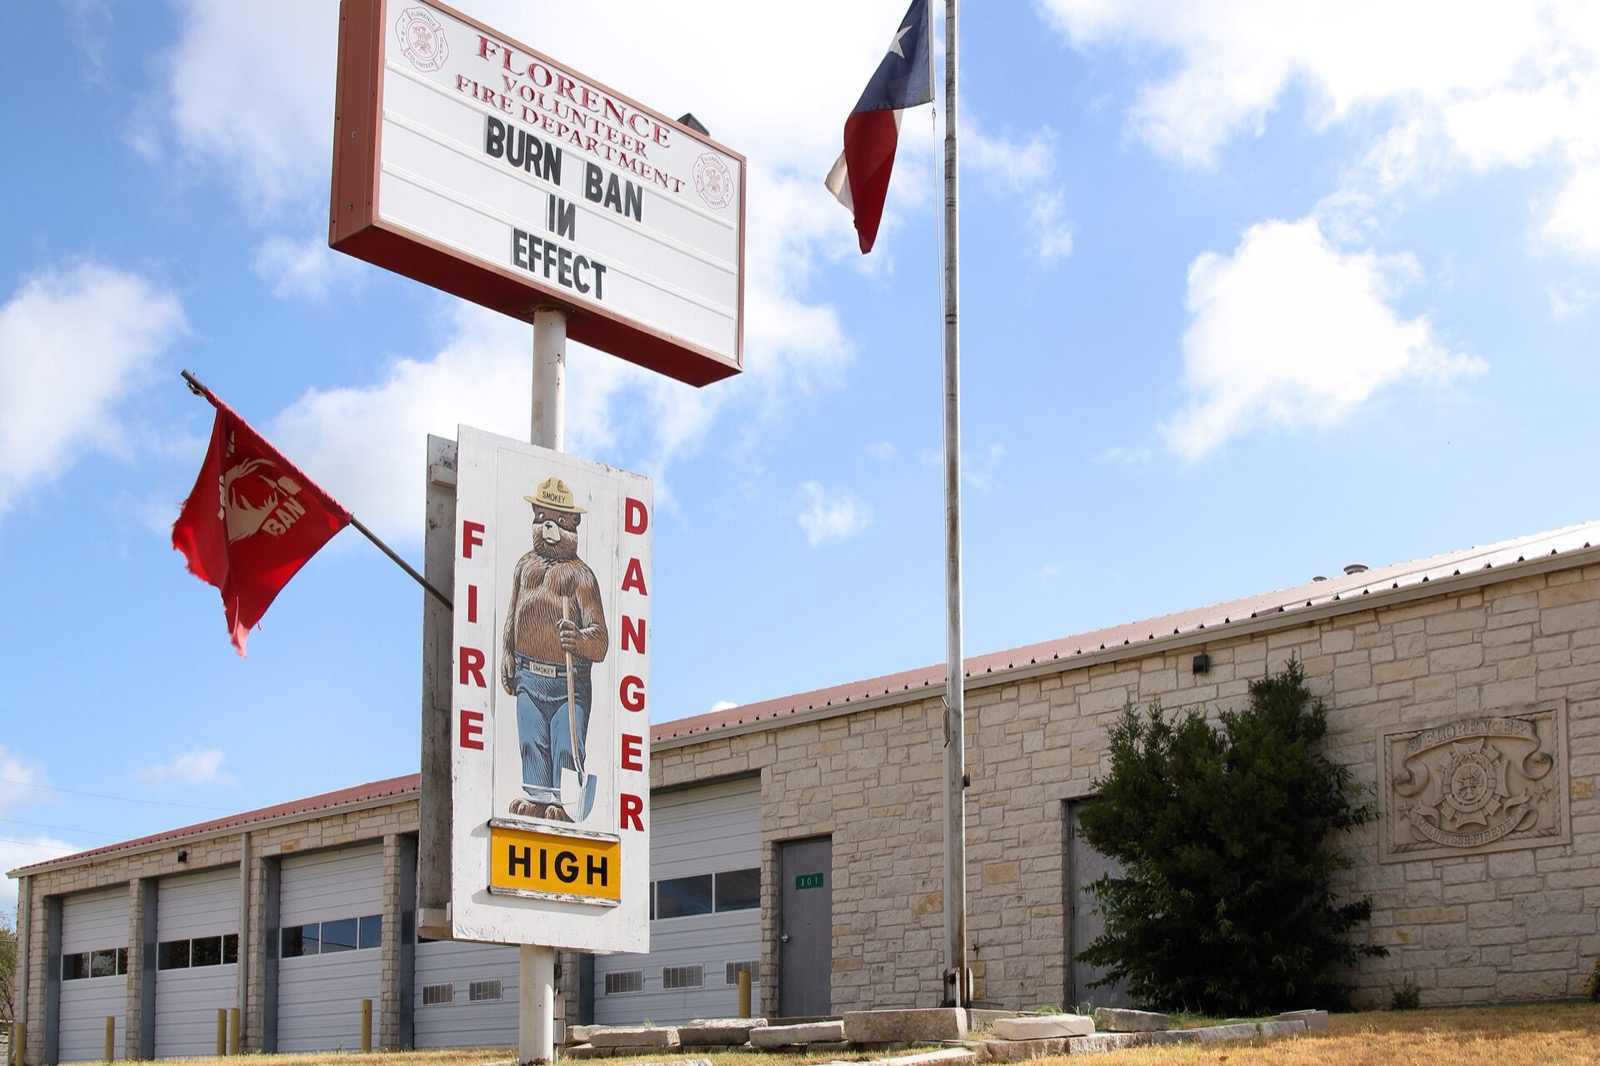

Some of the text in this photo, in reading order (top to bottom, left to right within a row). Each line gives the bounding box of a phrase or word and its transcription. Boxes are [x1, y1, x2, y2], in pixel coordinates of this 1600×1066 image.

[476, 34, 670, 149] FLORENCE
[501, 73, 649, 159] VOLUNTEER
[455, 73, 686, 193] FIRE DEPARTMENT
[486, 115, 643, 222] BURN BAN
[549, 193, 576, 241] IN
[513, 227, 606, 300] EFFECT
[261, 497, 306, 538] BAN
[542, 490, 565, 504] SMOKEY
[459, 520, 487, 750] FIRE
[619, 497, 648, 832] DANGER
[1425, 719, 1514, 747] FLORENCE
[508, 844, 608, 886] HIGH
[800, 876, 818, 887] 301
